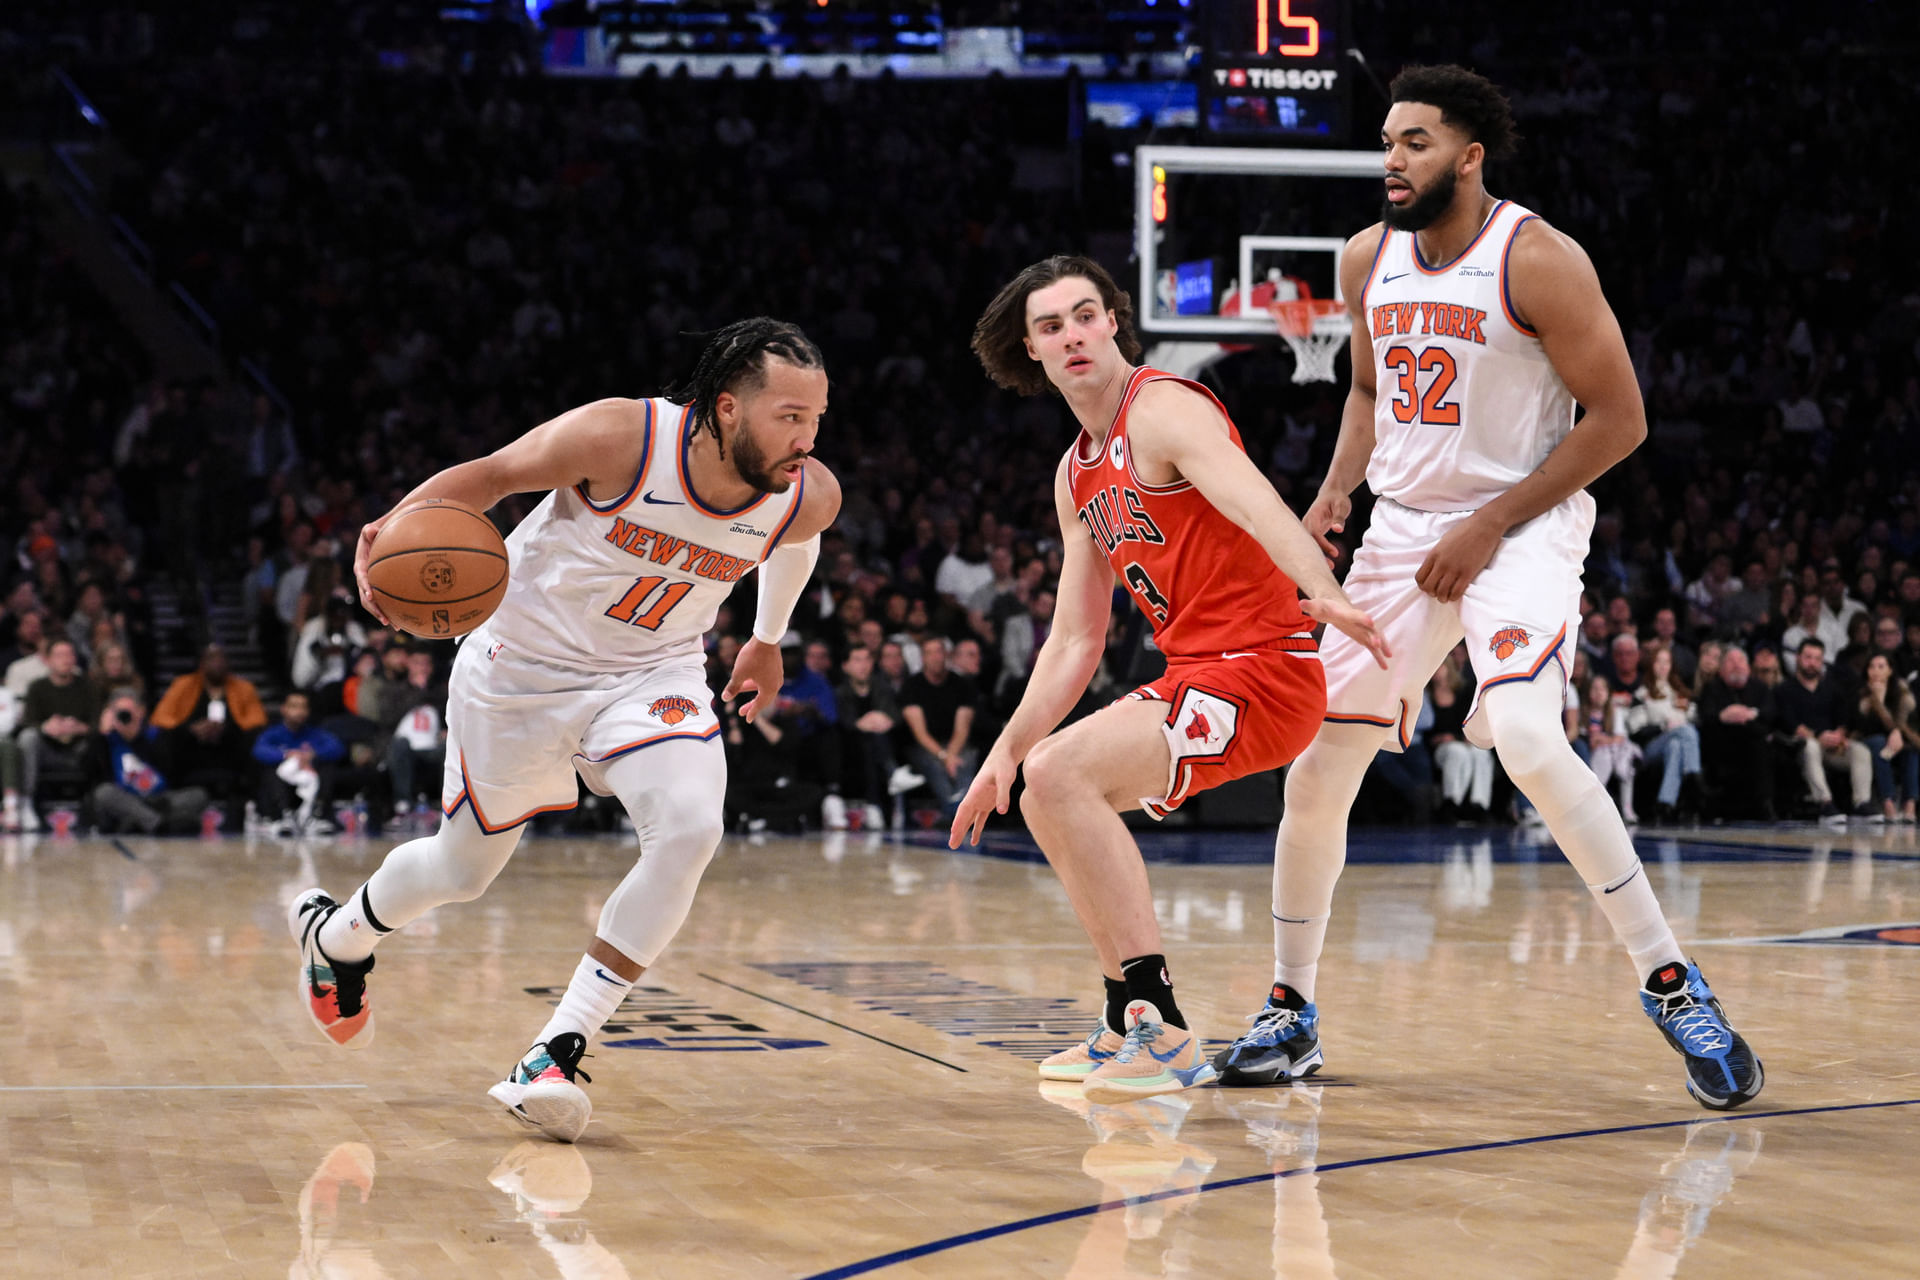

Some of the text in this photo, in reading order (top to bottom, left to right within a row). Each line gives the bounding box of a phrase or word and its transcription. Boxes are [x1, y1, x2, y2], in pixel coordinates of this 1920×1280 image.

[1256, 0, 1320, 56] 15
[1248, 68, 1338, 91] TISSOT
[1373, 302, 1487, 345] NEW YORK
[1384, 346, 1461, 427] 32
[604, 516, 757, 583] NEW YORK
[729, 526, 745, 534] abu
[604, 575, 696, 633] 11
[1124, 561, 1169, 625] 3
[648, 697, 699, 716] KNICKS
